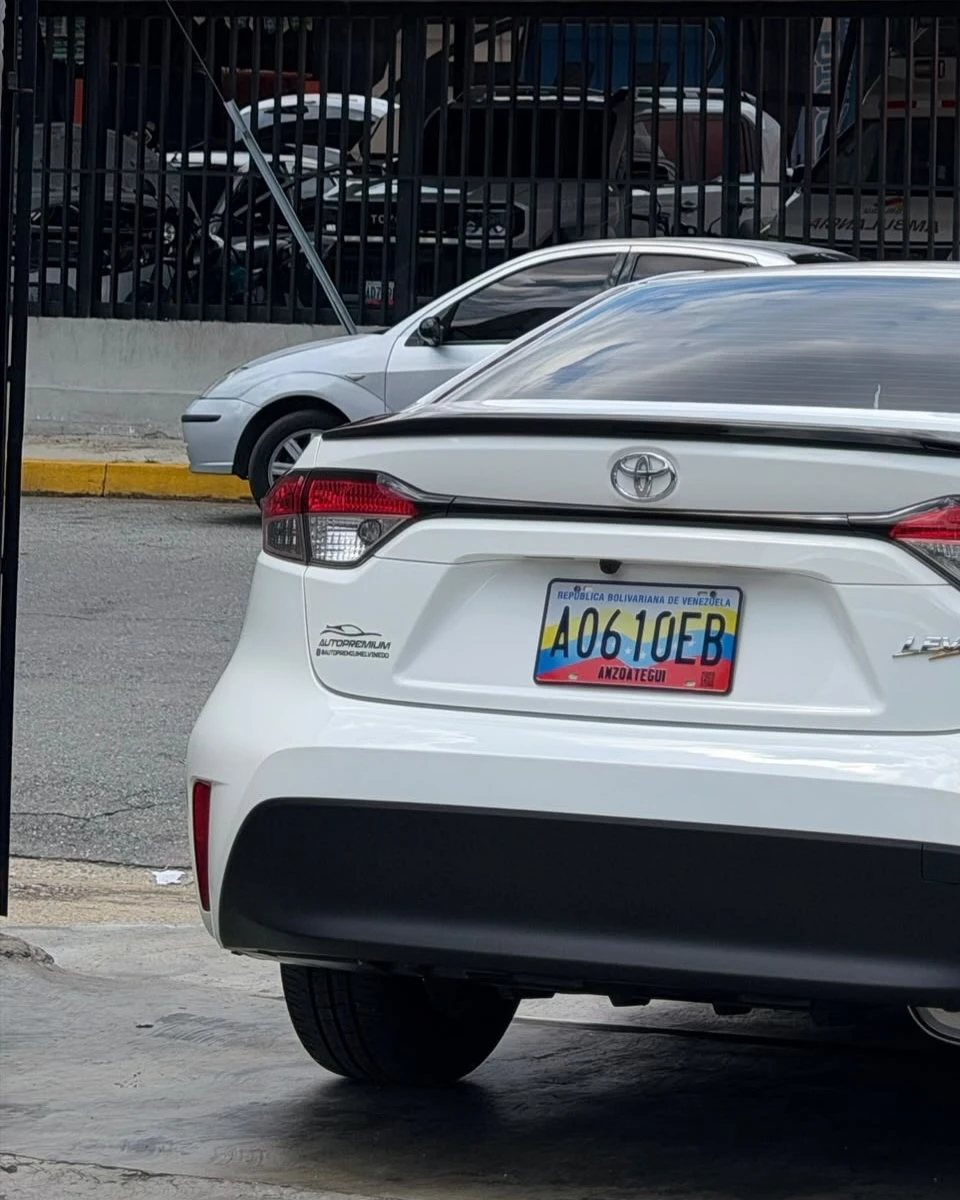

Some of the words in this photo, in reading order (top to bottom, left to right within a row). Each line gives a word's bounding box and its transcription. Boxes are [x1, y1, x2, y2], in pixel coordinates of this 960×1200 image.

[607, 593, 665, 605] BOLIVARIANA
[667, 596, 680, 606] DE
[682, 596, 731, 607] VENEZUELA
[318, 639, 391, 650] AUTOPREMIUM
[597, 667, 667, 683] ANZOATEGUI
